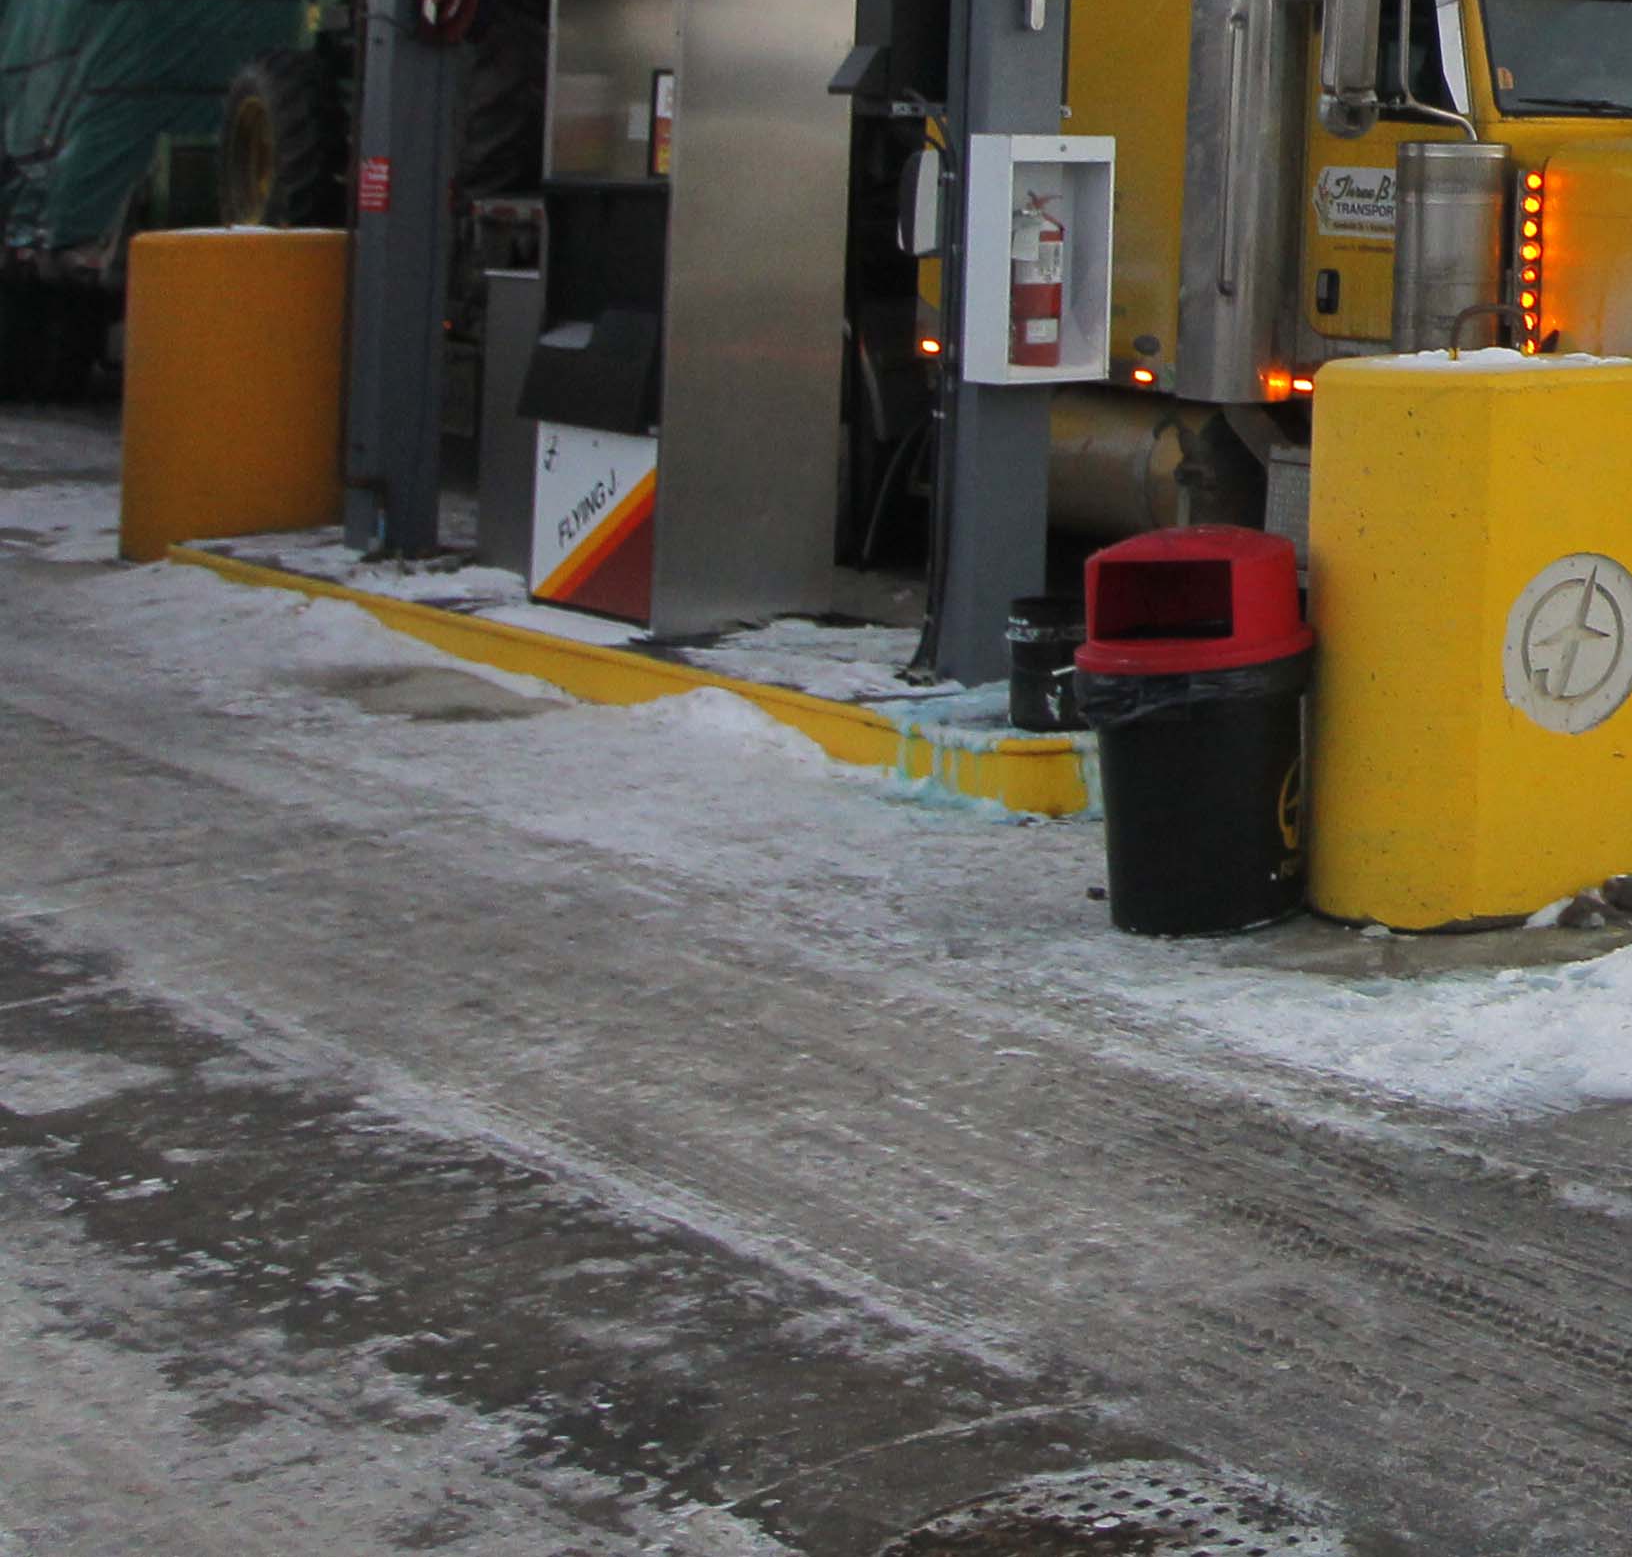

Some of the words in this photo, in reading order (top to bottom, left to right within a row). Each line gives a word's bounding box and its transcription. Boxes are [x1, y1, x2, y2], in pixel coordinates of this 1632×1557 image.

[1336, 202, 1396, 217] TRANSPOR
[557, 480, 607, 549] FLYING
[607, 467, 617, 496] J
